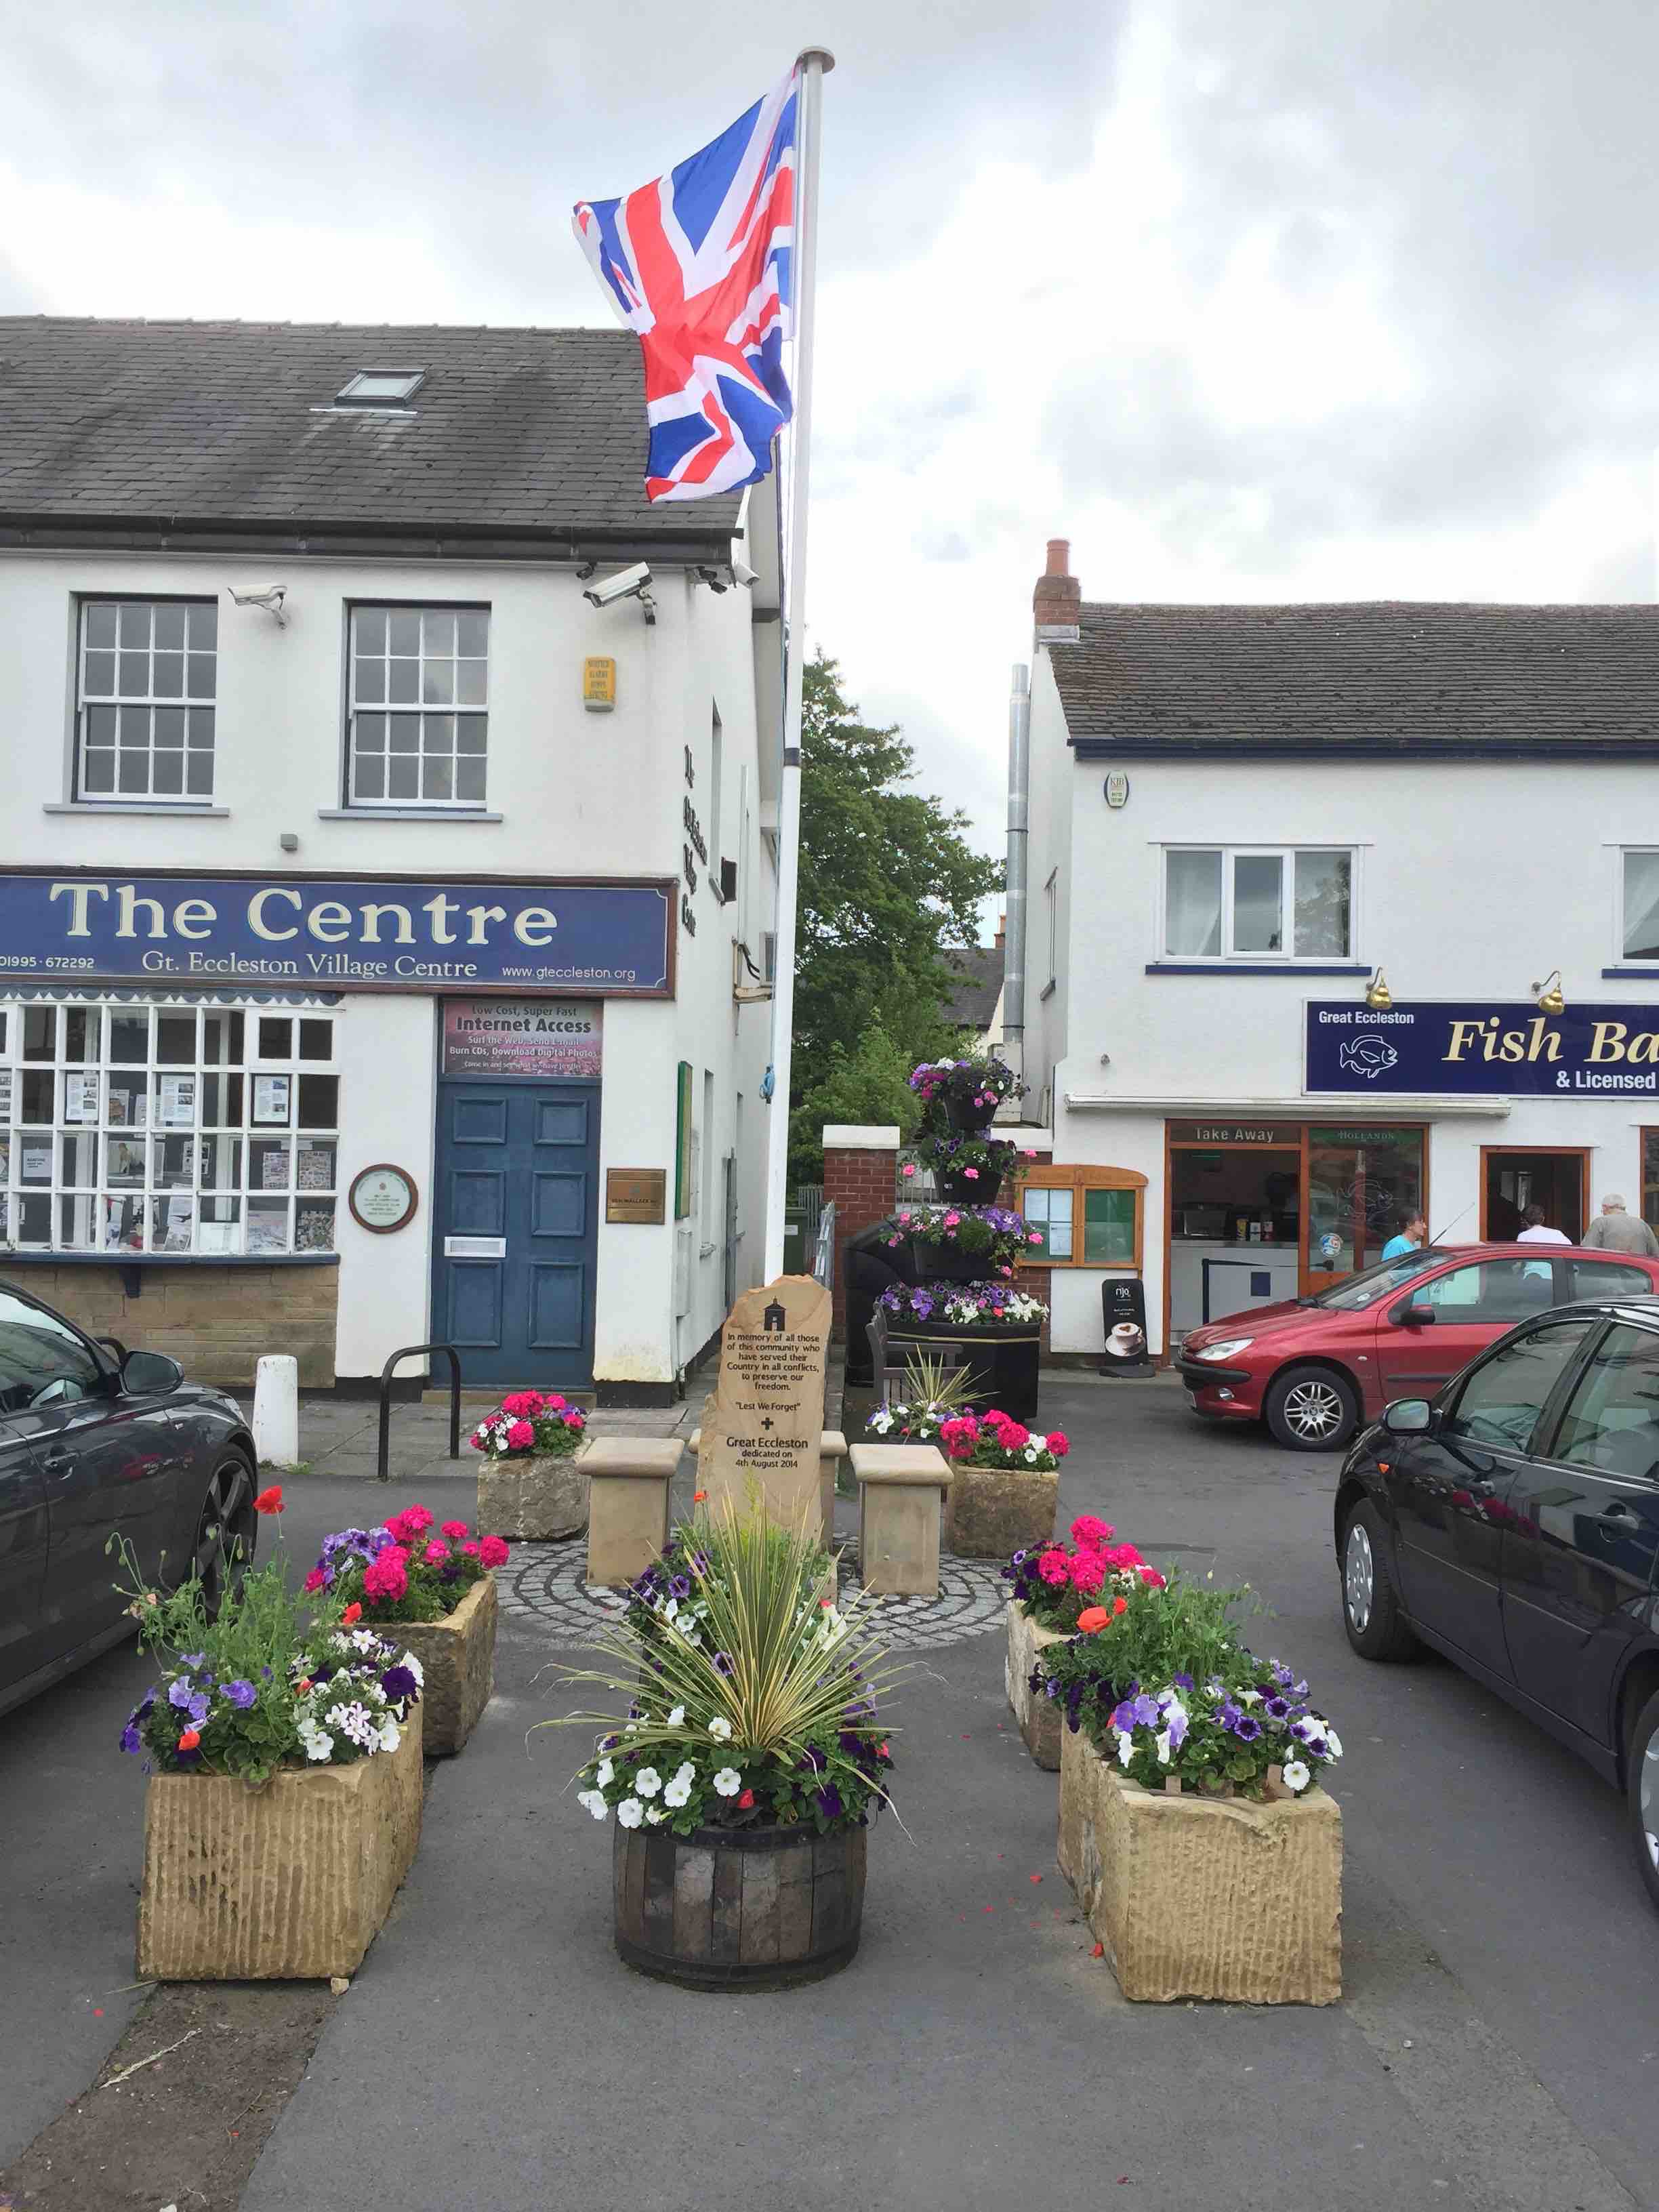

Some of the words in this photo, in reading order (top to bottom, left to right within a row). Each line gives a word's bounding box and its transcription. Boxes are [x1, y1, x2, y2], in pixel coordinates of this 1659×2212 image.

[49, 882, 218, 939] The
[247, 887, 558, 946] Centre
[45, 956, 95, 968] 672292
[142, 950, 180, 971] Gt.
[188, 951, 299, 974] Eccleston
[306, 954, 388, 979] Village
[394, 956, 477, 977] Centre
[501, 966, 636, 982] www.gteccleston.org
[472, 1005, 492, 1015] Low
[496, 1006, 520, 1017] Cost,
[523, 1007, 553, 1017] Super
[556, 1008, 577, 1017] Fast
[1319, 1010, 1353, 1024] Great
[1355, 1011, 1414, 1024] Eccleston
[457, 1017, 531, 1031] Internet
[535, 1019, 592, 1033] Access
[1441, 1017, 1564, 1062] Fish
[472, 1047, 489, 1056] CDs,
[492, 1047, 535, 1056] Download
[1556, 1071, 1570, 1088] &
[1576, 1071, 1656, 1089] Licensed
[1194, 1128, 1229, 1139] Take
[1235, 1128, 1274, 1143] Away
[737, 1334, 771, 1343] memory
[786, 1334, 795, 1342] all
[797, 1334, 819, 1343] those
[756, 1344, 799, 1352] community
[726, 1361, 760, 1371] Country
[783, 1364, 819, 1373] conflicts,
[752, 1374, 787, 1382] preserve
[755, 1382, 791, 1391] freedom.
[758, 1402, 770, 1410] We
[726, 1437, 756, 1447] Great
[758, 1437, 808, 1448] Eccleston
[741, 1450, 780, 1458] dedicated
[735, 1459, 748, 1467] 4th
[751, 1460, 778, 1469] August
[781, 1460, 798, 1468] 2014
